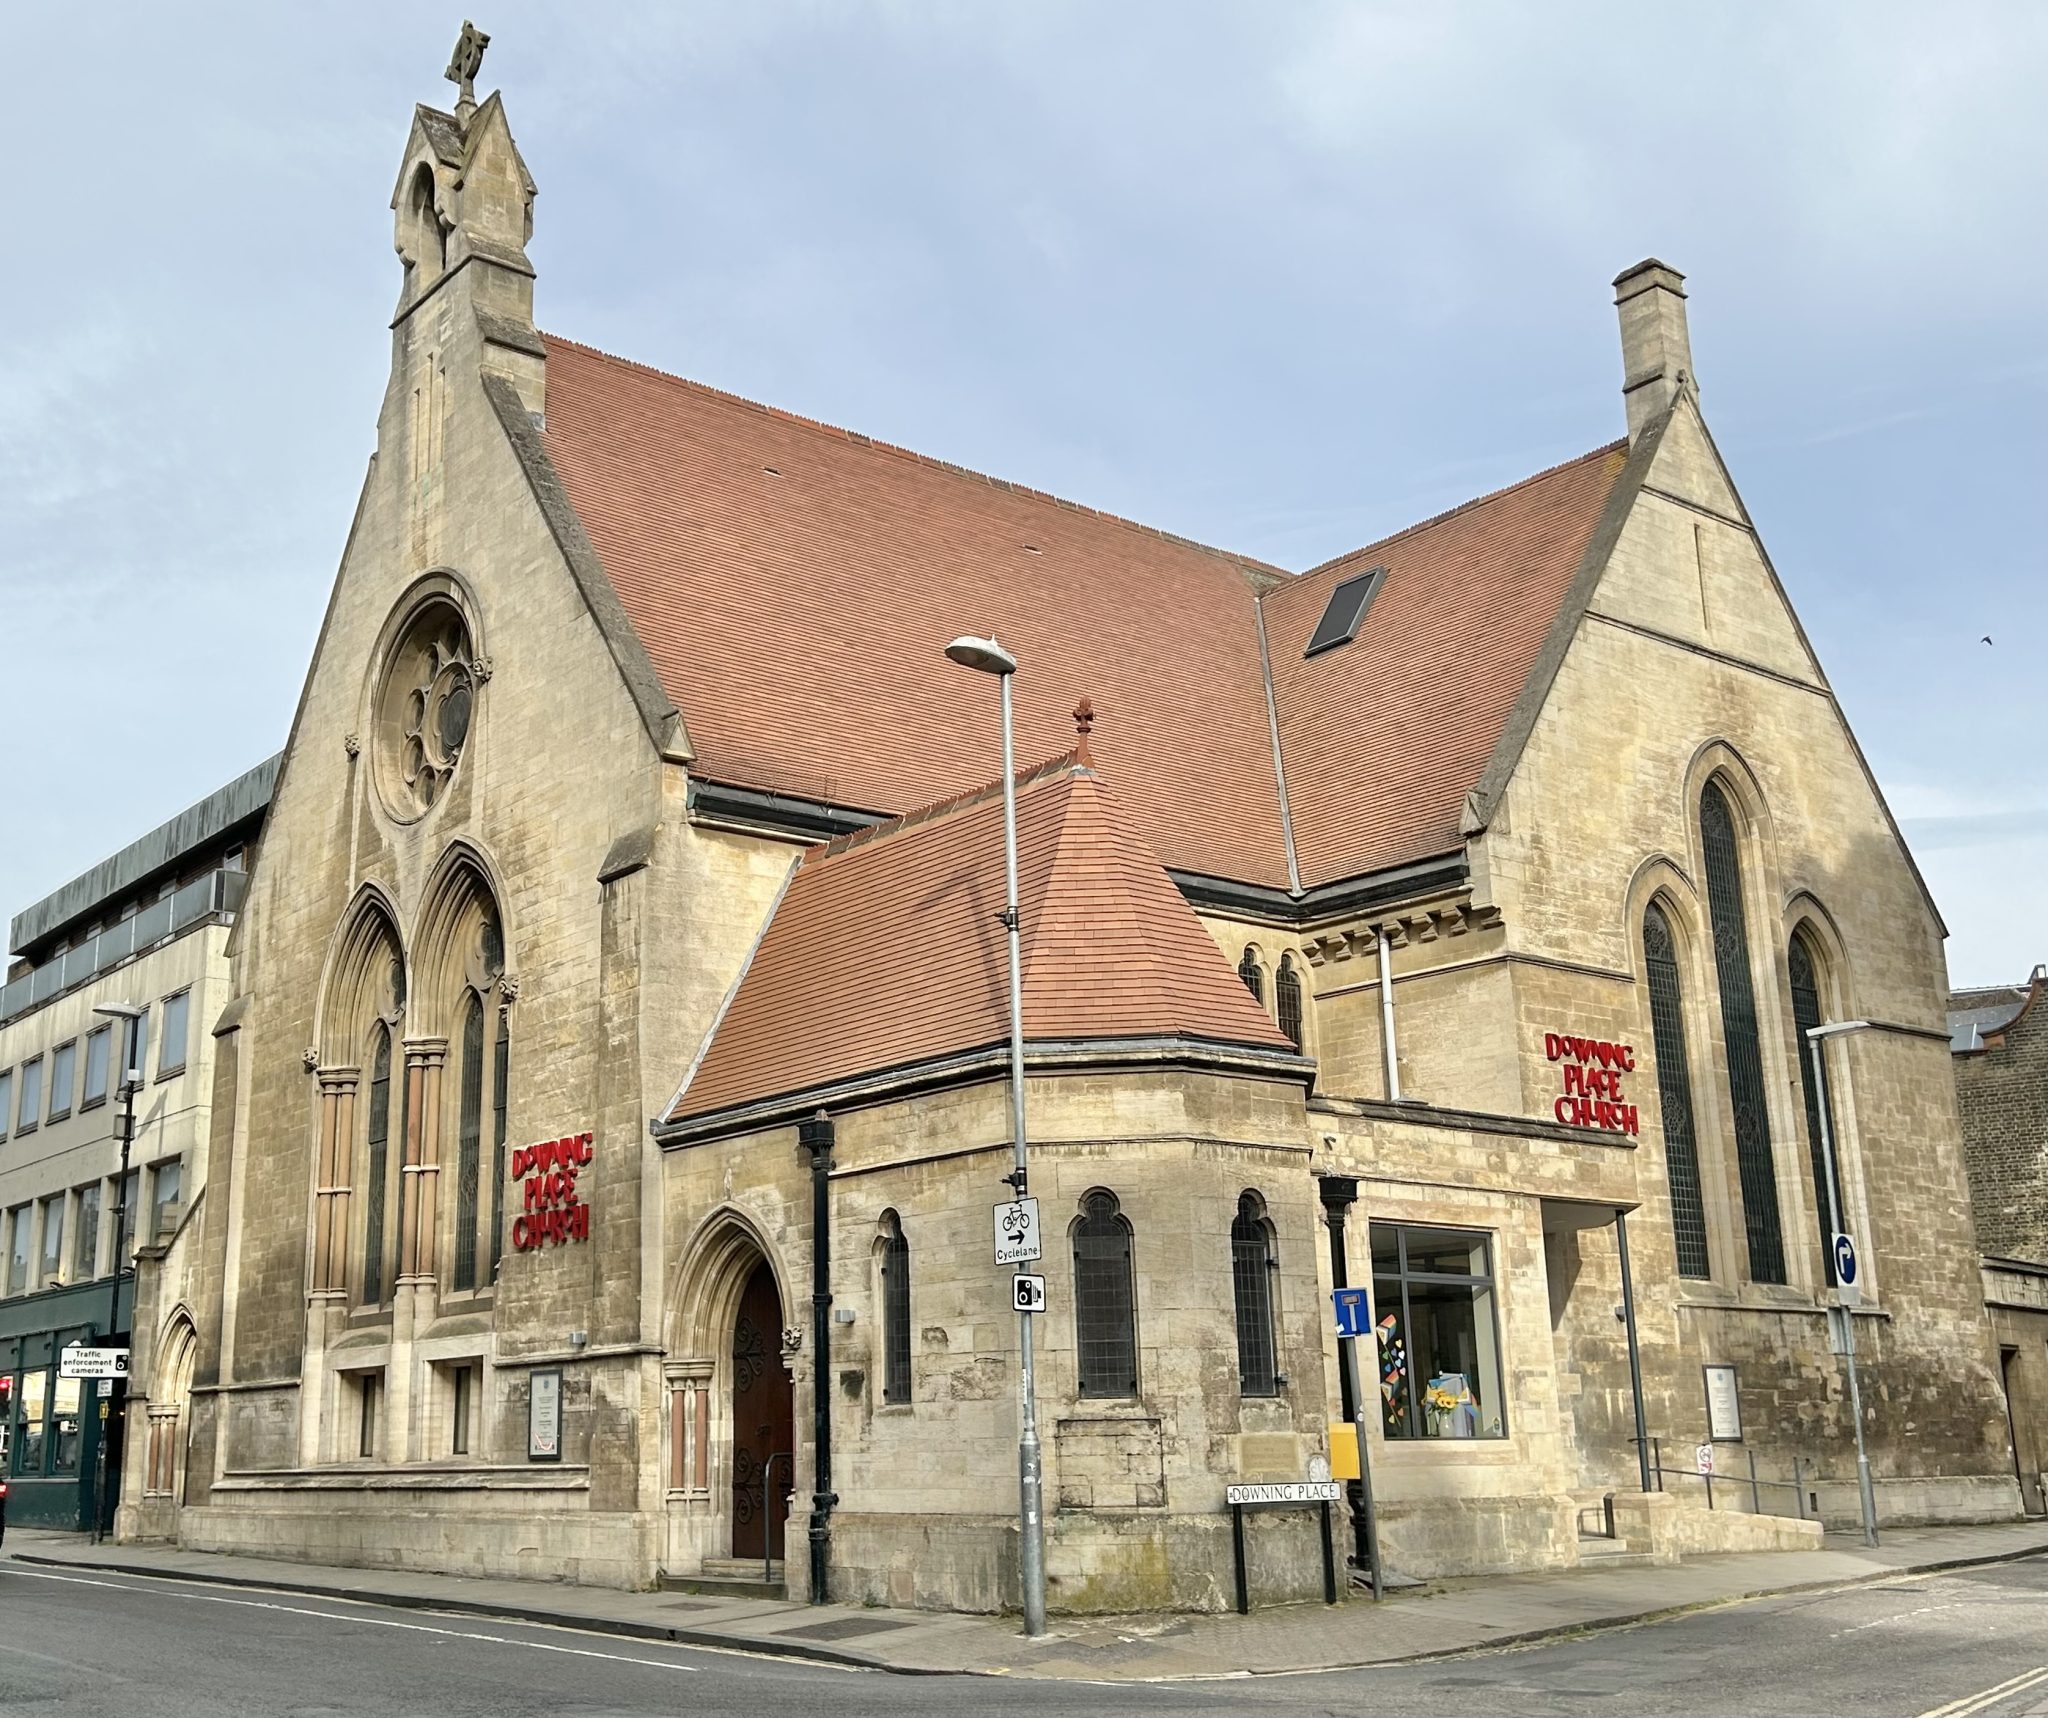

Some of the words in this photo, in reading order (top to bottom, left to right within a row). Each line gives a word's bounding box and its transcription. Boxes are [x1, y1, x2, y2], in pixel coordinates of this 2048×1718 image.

[1545, 1033, 1635, 1072] DOWNING
[1563, 1064, 1624, 1102] PLACE
[1554, 1096, 1639, 1136] CHURCH
[512, 1132, 593, 1181] DOWNING
[524, 1168, 578, 1212] PLACE
[513, 1203, 589, 1251] CHURCH
[76, 1350, 101, 1358] Traffic
[1232, 1485, 1292, 1502] DOWNING
[1298, 1484, 1336, 1499] PLACE
